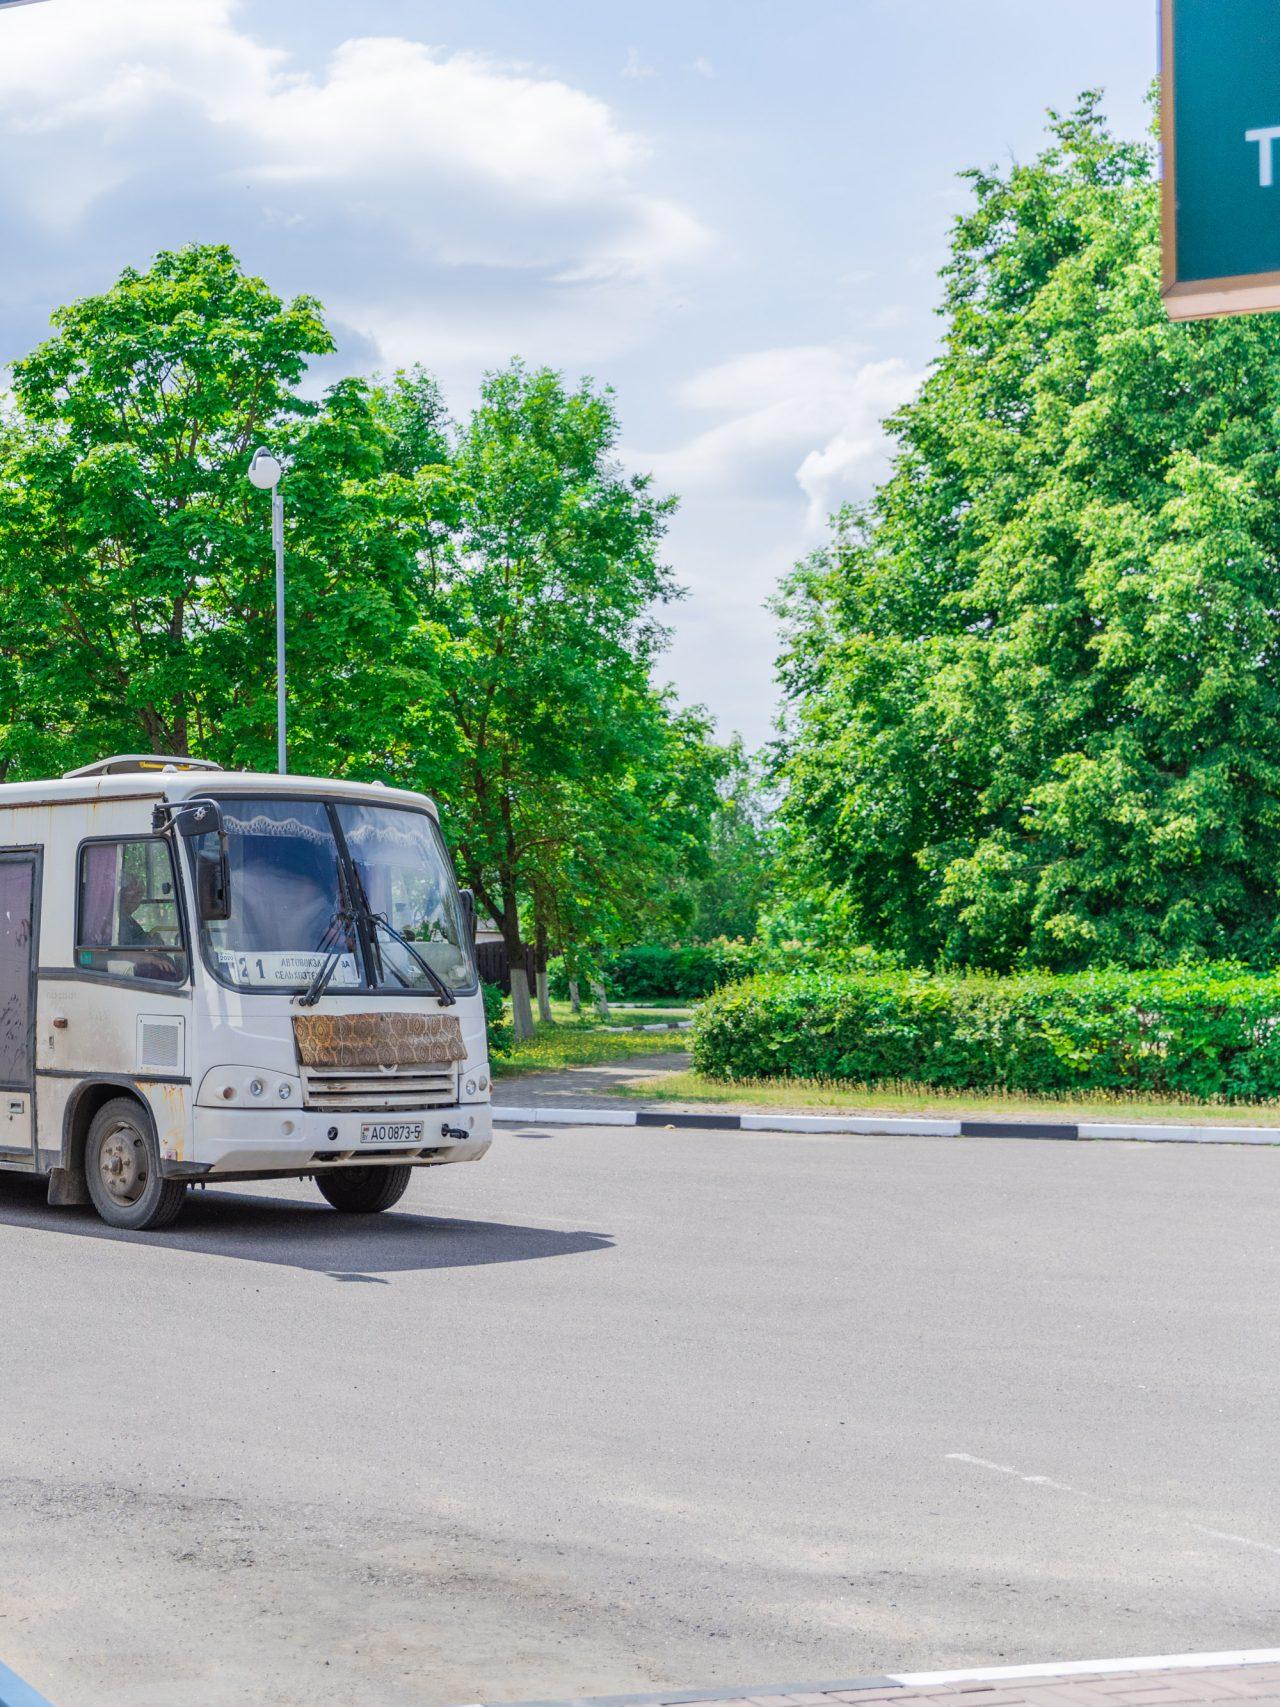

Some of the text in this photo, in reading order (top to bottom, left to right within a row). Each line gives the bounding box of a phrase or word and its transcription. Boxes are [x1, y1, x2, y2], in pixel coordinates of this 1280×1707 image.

[255, 958, 266, 979] 1
[370, 1125, 422, 1140] AO 0873-5
